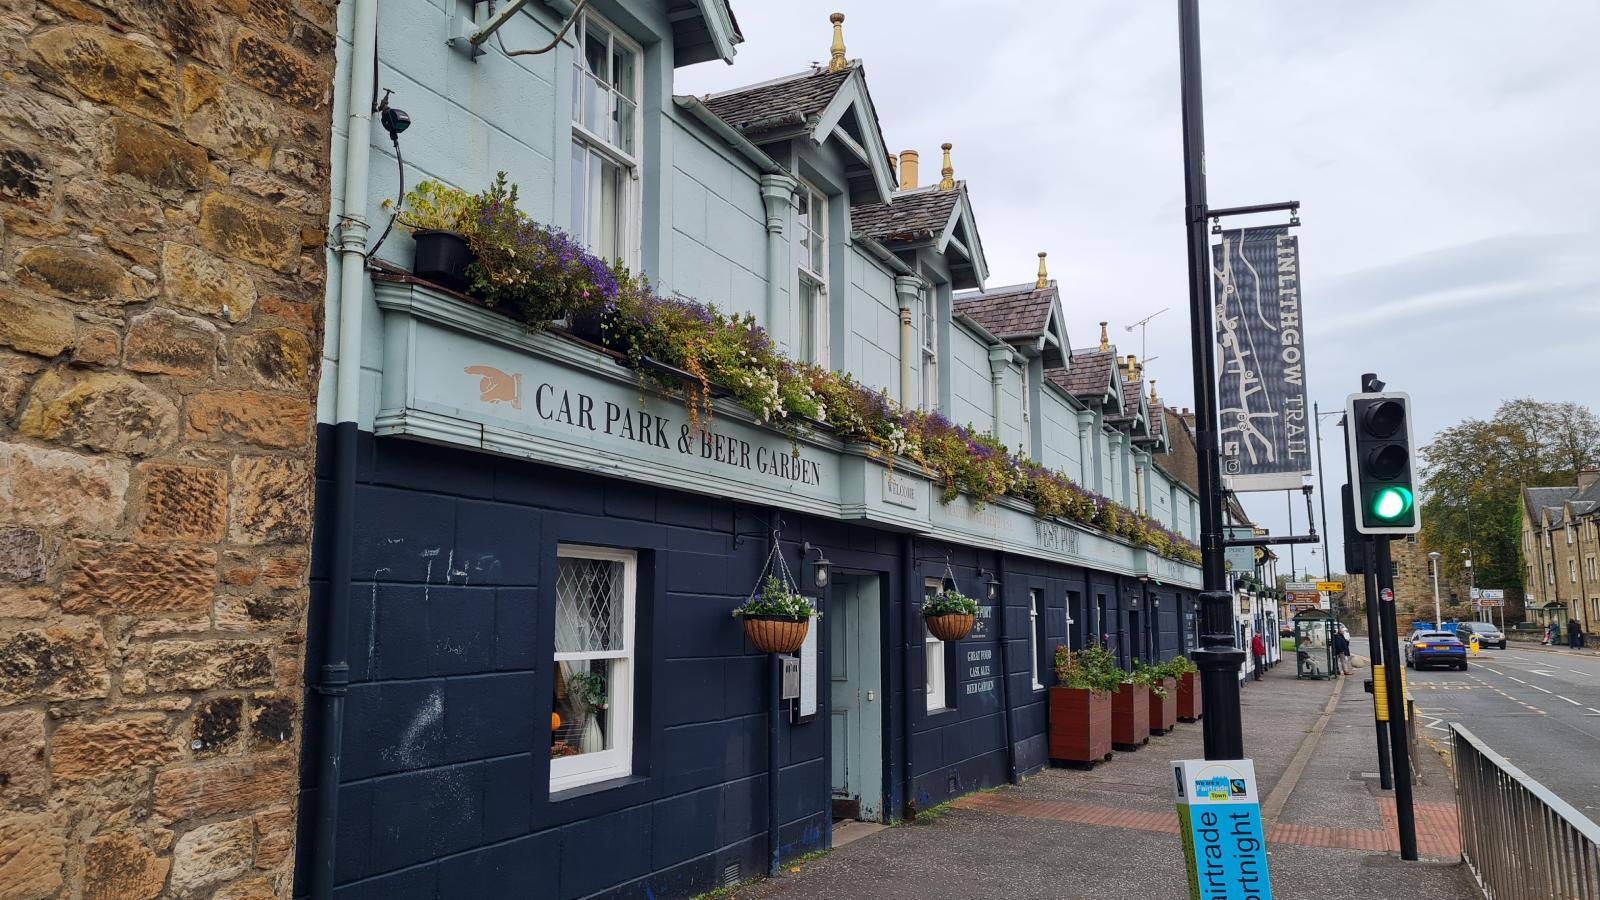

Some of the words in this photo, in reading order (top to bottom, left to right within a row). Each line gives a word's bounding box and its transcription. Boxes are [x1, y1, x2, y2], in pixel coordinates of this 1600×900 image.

[1276, 234, 1303, 386] LINLITHGOW
[535, 382, 597, 431] CAR
[604, 401, 672, 450] PARK
[678, 423, 694, 455] &
[701, 428, 752, 471] BEER
[757, 446, 821, 486] GARDEN
[1285, 394, 1307, 460] TRAIL
[1034, 519, 1059, 550] WEST
[1061, 527, 1080, 554] PORT
[967, 650, 981, 661] GREAT
[981, 649, 992, 660] FOOD
[969, 667, 981, 677] CASK
[981, 666, 990, 676] ALES
[966, 683, 978, 694] BEER
[978, 681, 994, 693] GARDEN
[1196, 784, 1229, 792] Fairtrade
